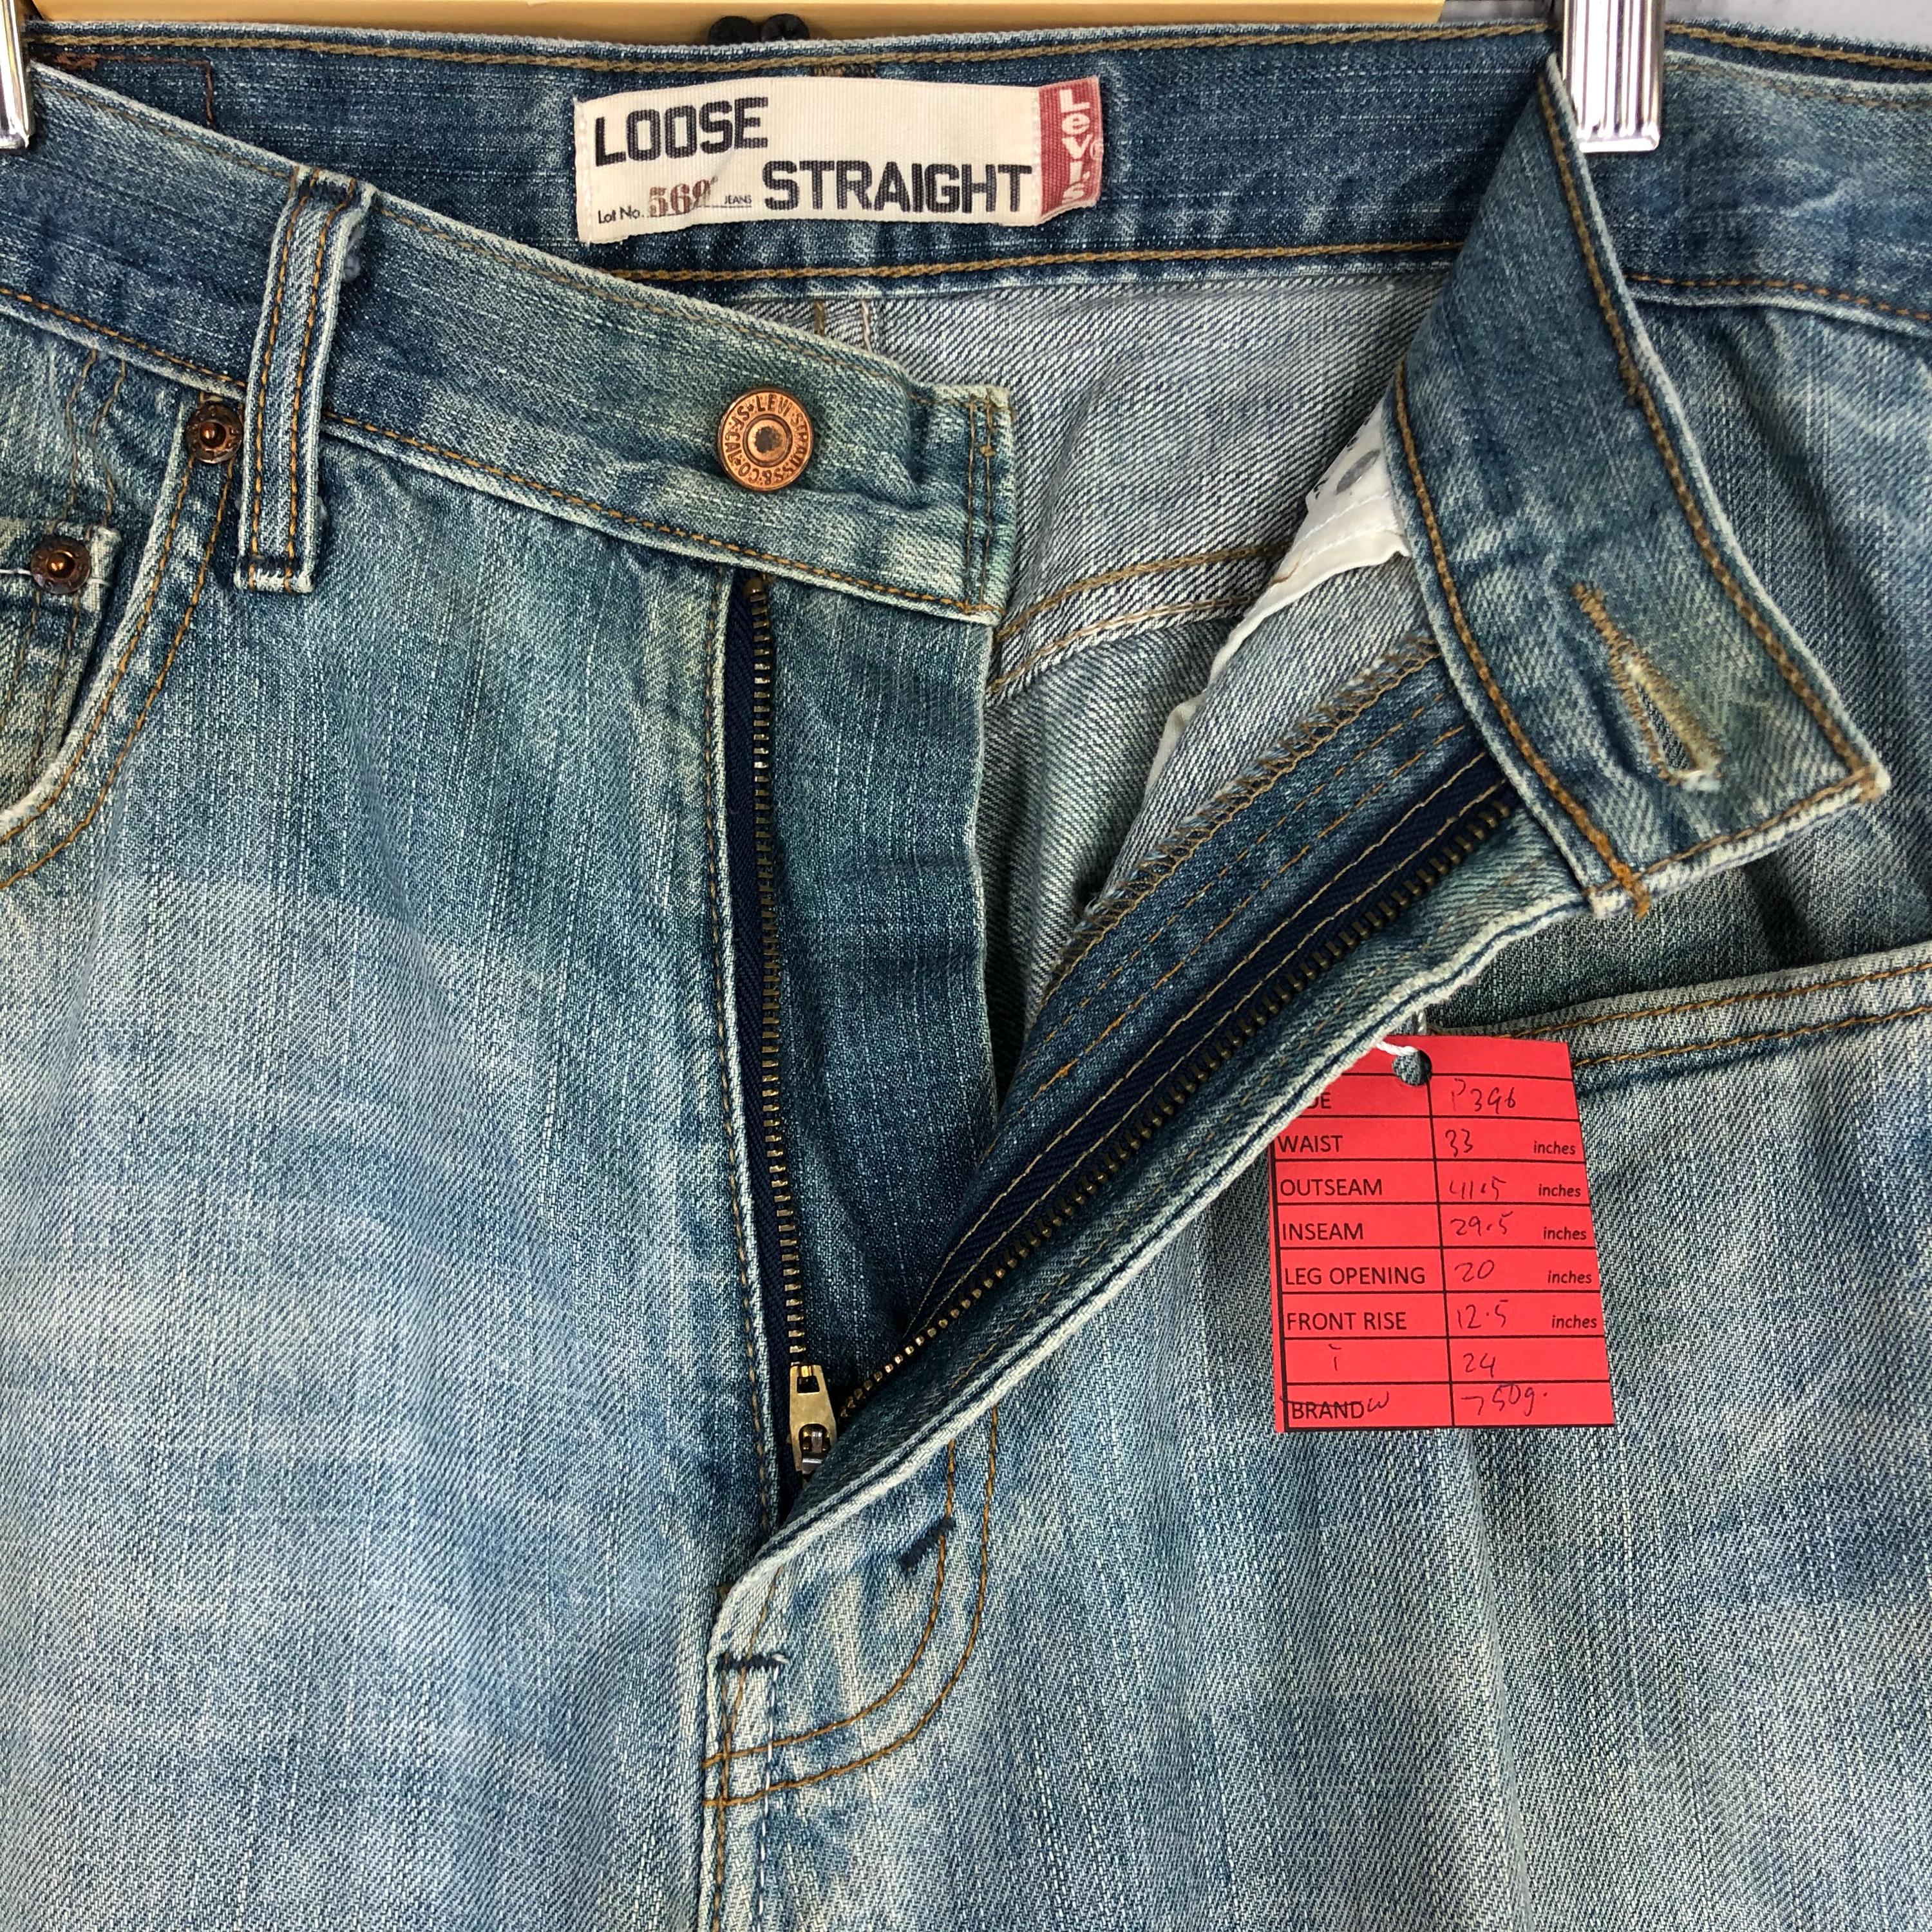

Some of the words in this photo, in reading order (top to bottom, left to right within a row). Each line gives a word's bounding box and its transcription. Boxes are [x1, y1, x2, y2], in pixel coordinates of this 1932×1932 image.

[594, 97, 769, 167] LOOSE
[762, 160, 1032, 214] STRAIGHT
[724, 194, 752, 205] JEANS
[598, 209, 616, 224] Lot
[1277, 1135, 1343, 1153] WAIST
[1444, 1128, 1473, 1158] 33
[1533, 1141, 1576, 1155] inches
[1280, 1178, 1383, 1197] OUTSEAM
[1538, 1184, 1582, 1198] inches
[1283, 1222, 1364, 1240] INSEAM
[1450, 1210, 1514, 1237] 29.5
[1543, 1226, 1587, 1240] inches
[1285, 1267, 1322, 1285] LEG
[1329, 1266, 1426, 1285] OPENING
[1454, 1259, 1495, 1283] 20
[1547, 1270, 1593, 1284] inches
[1287, 1312, 1357, 1331] FRONT
[1363, 1311, 1407, 1330] RISE
[1456, 1298, 1509, 1330] 12.5
[1551, 1314, 1598, 1329] inches
[1463, 1353, 1496, 1378] 24
[1291, 1400, 1365, 1421] BRAND
